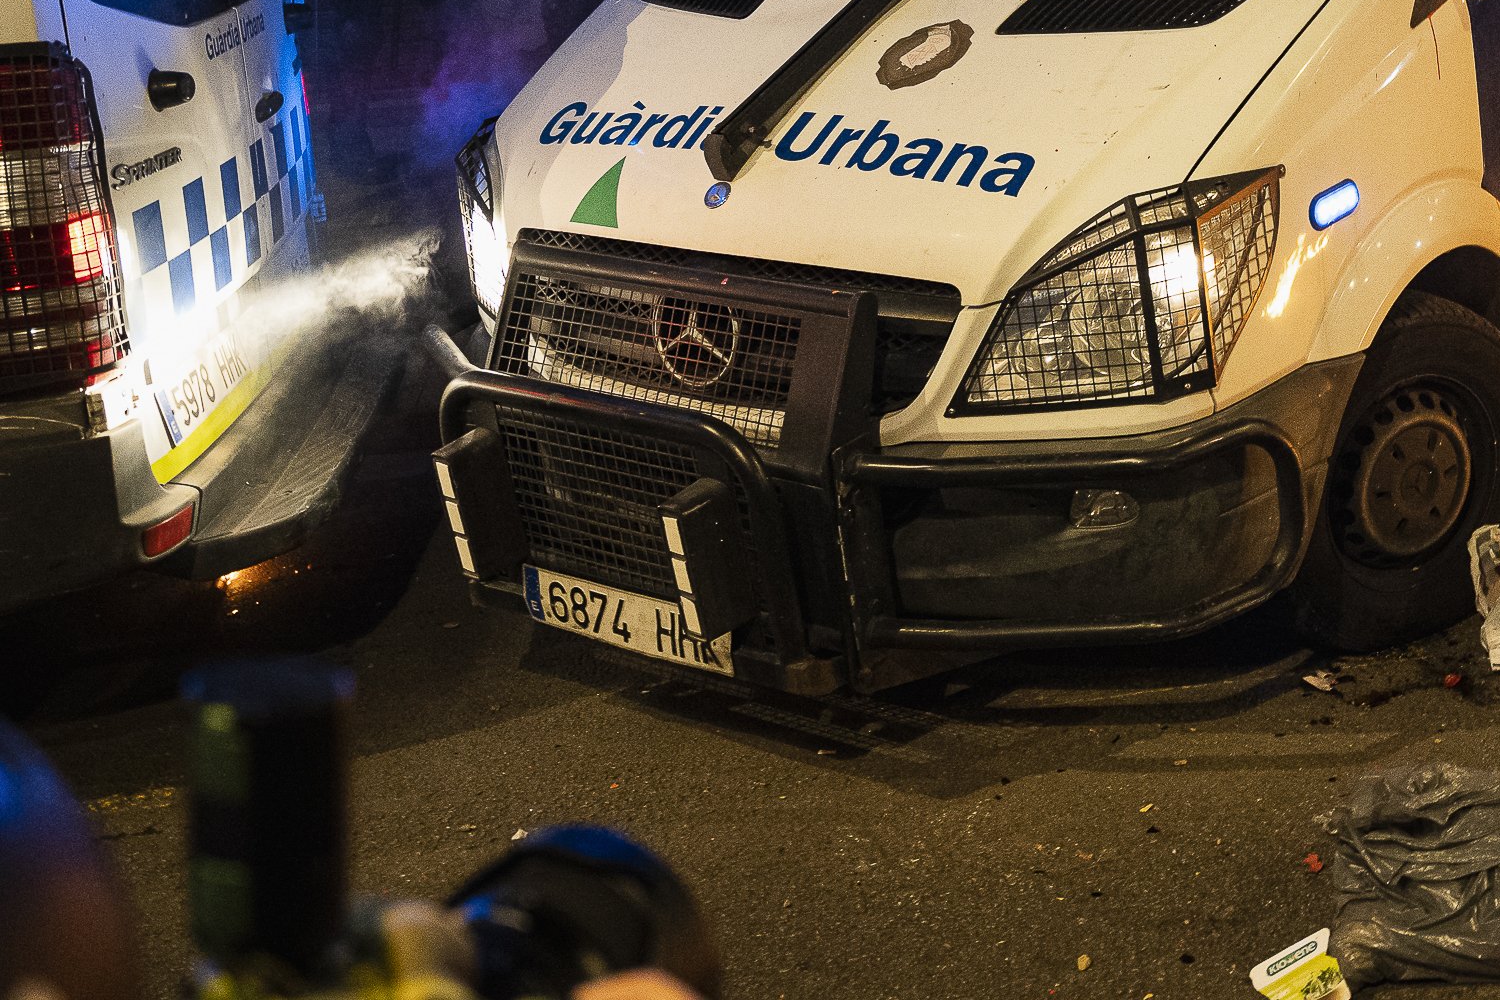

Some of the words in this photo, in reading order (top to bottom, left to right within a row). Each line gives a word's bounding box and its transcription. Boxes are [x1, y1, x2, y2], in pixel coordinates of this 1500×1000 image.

[204, 25, 240, 61] Guàrdia
[239, 13, 265, 43] Urbana
[539, 101, 725, 152] Guàrdi
[774, 111, 1036, 198] Urbana
[171, 363, 216, 427] 5978
[548, 581, 631, 644] 6874
